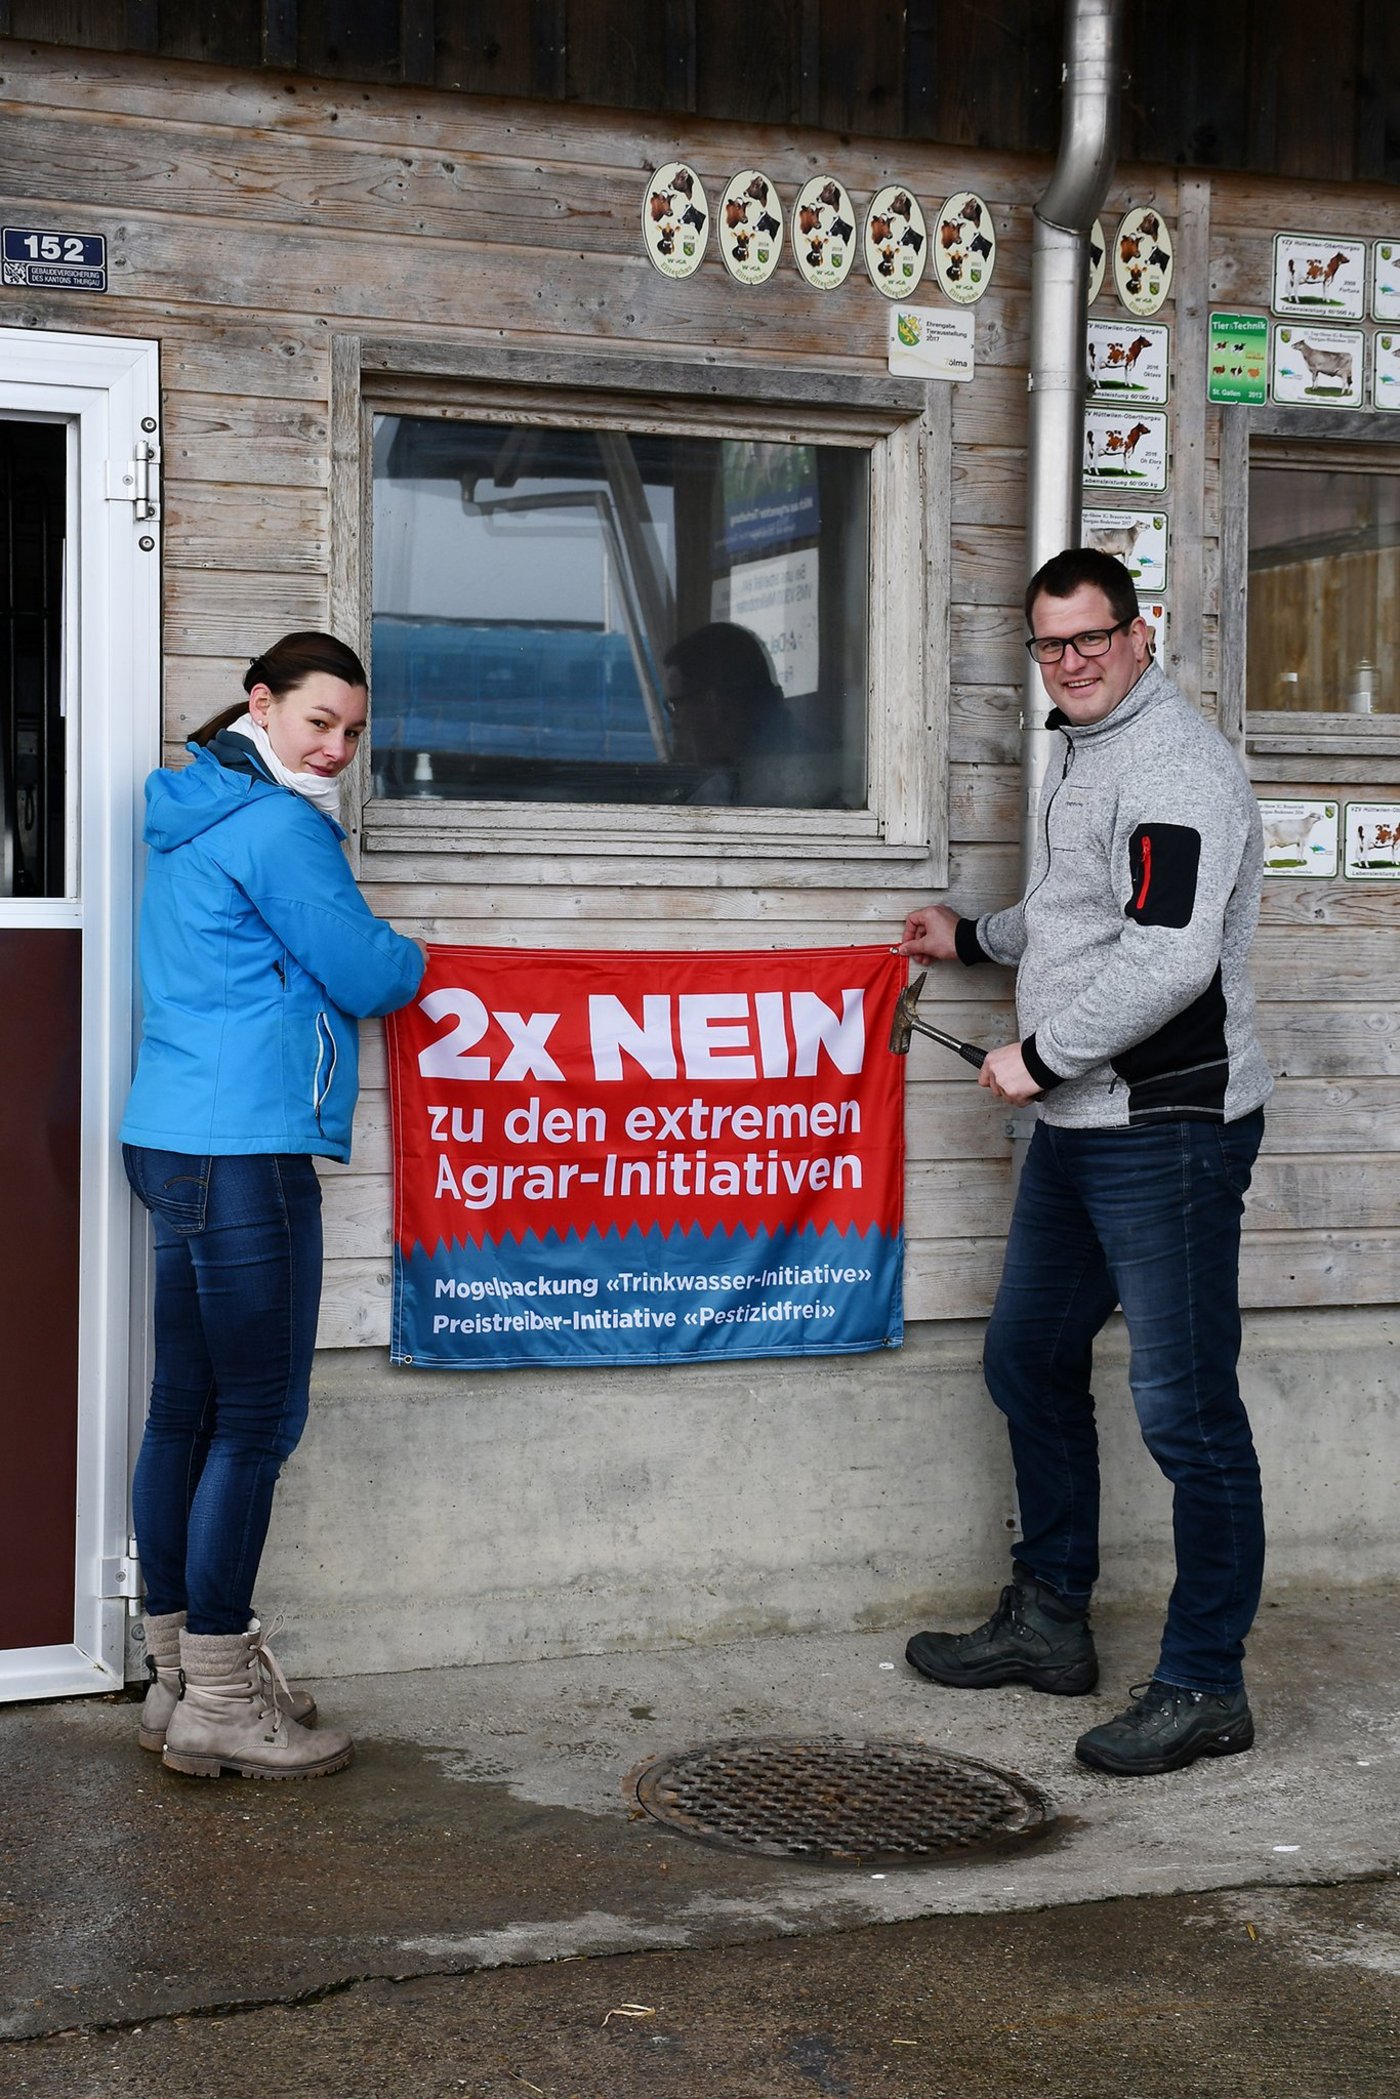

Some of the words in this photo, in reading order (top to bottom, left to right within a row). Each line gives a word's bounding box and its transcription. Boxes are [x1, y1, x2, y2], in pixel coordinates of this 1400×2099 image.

[24, 235, 84, 262] 152
[44, 276, 72, 284] KANTONS
[74, 278, 100, 287] THURGAU
[926, 321, 956, 329] Ehrengabe
[926, 329, 968, 338] Tierausstellung
[1221, 388, 1241, 397] Gallen
[417, 987, 567, 1082] 2x
[588, 988, 866, 1082] NEIN
[427, 1105, 484, 1143] zu
[504, 1096, 606, 1144] den
[624, 1098, 861, 1141] extremen
[434, 1149, 862, 1210] Agrar-Initiativen
[435, 1275, 599, 1301] Mogelpackung
[606, 1263, 872, 1296] «Trinkwasser-Initiative»
[433, 1309, 677, 1334] Preistreiber-Initiative
[683, 1300, 836, 1327] «Pestizidfrei»
